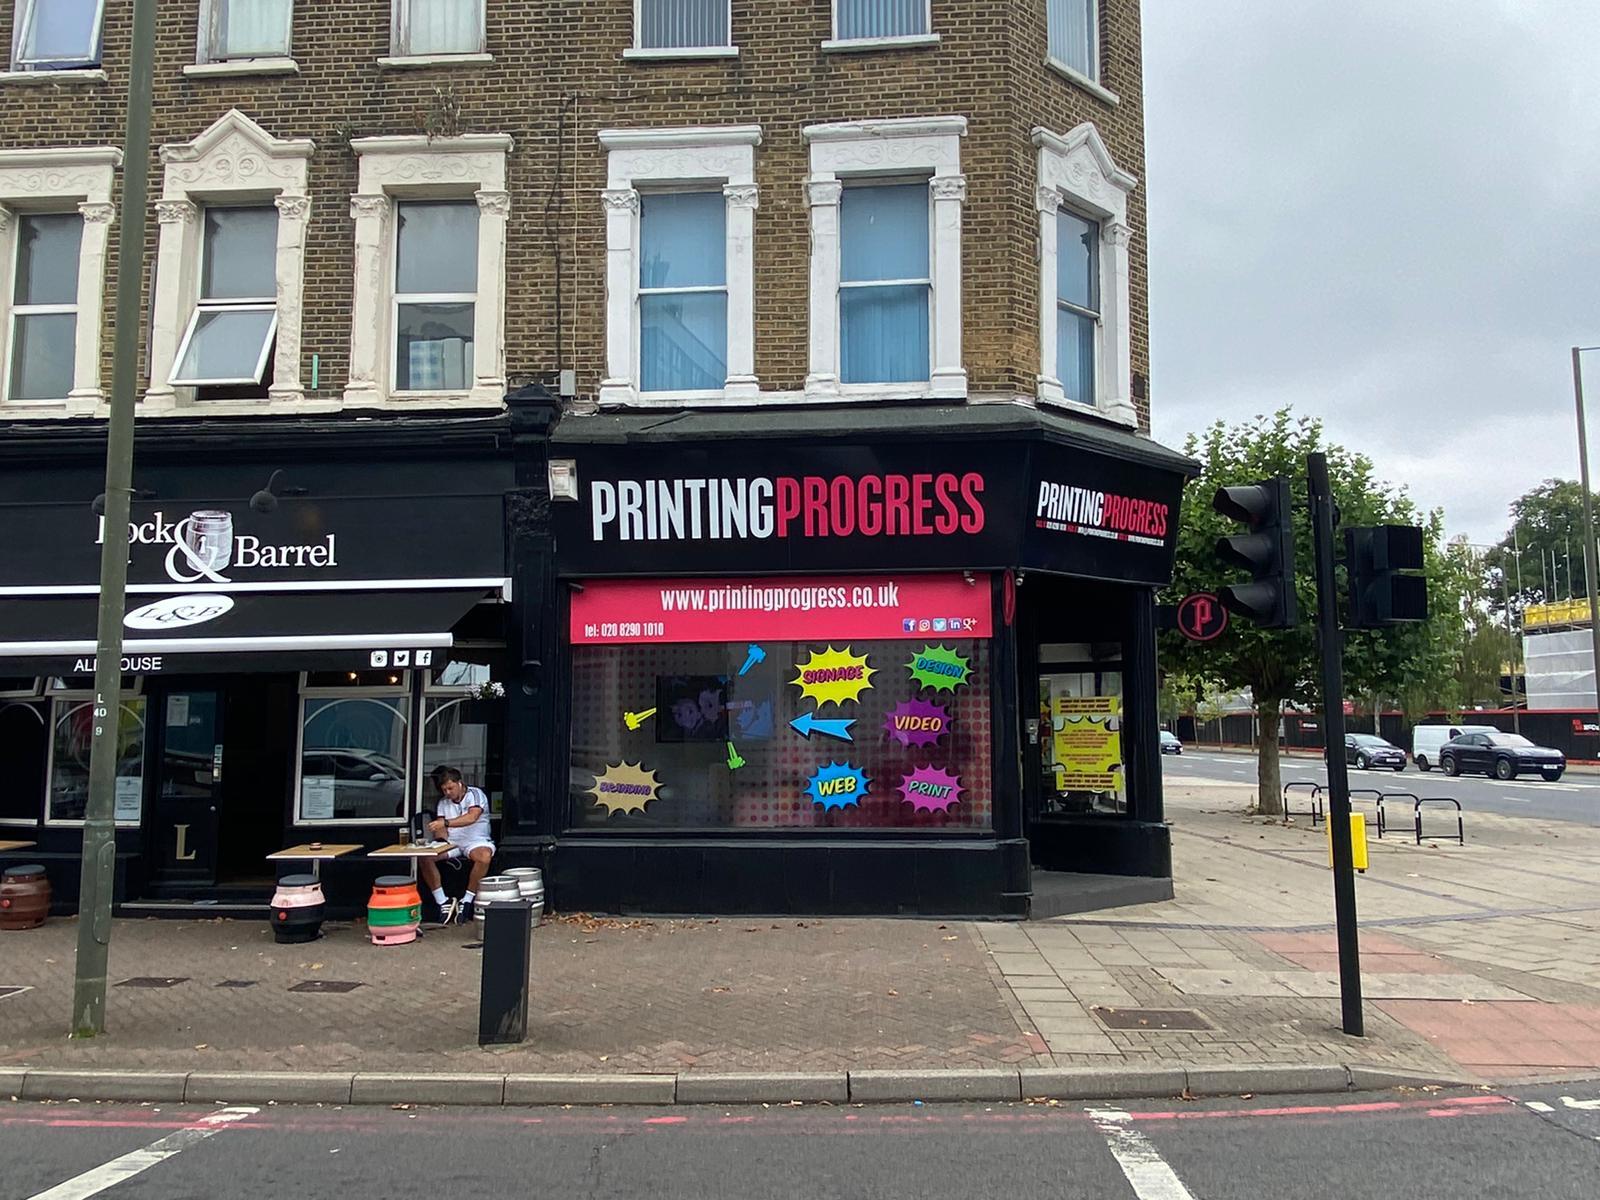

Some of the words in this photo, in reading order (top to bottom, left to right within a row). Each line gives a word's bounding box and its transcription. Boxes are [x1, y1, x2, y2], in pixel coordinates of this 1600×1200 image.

[233, 533, 338, 568] Barrel
[660, 581, 900, 613] www.printingprogress.co.uk
[585, 623, 600, 638] tel:
[601, 622, 618, 637] 020
[619, 622, 641, 637] 8290
[643, 622, 664, 637] 1010
[73, 656, 163, 672] ALOUSE
[802, 655, 865, 685] SIGNAGE
[916, 656, 964, 679] DESIGN
[97, 693, 105, 704] L
[95, 726, 103, 736] 9
[894, 714, 942, 732] VIDEO
[600, 782, 652, 796] BRANDING
[817, 776, 857, 796] WEB
[908, 780, 952, 799] PRINT
[173, 824, 196, 860] L
